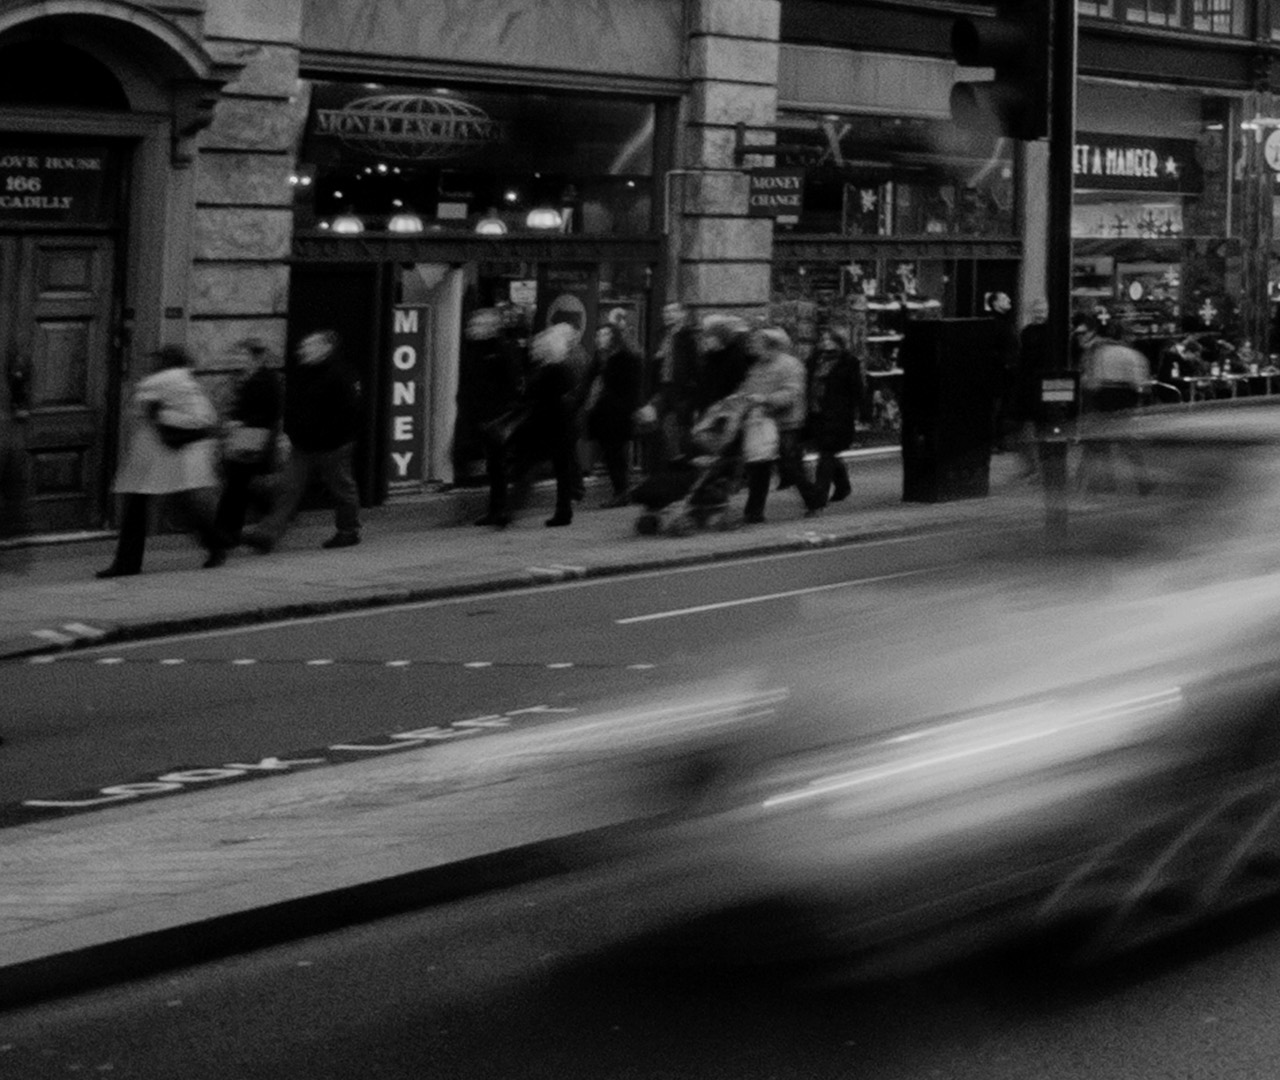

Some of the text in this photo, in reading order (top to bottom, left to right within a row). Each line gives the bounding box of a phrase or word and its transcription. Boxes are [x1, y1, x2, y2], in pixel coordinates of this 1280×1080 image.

[0, 155, 39, 169] OVE
[1073, 144, 1090, 175] ET
[1105, 147, 1158, 177] MANGER
[751, 176, 801, 189] MONEY
[751, 194, 801, 207] CHANGE
[391, 308, 419, 476] MONEY
[22, 704, 579, 807] LOOK LEFT
